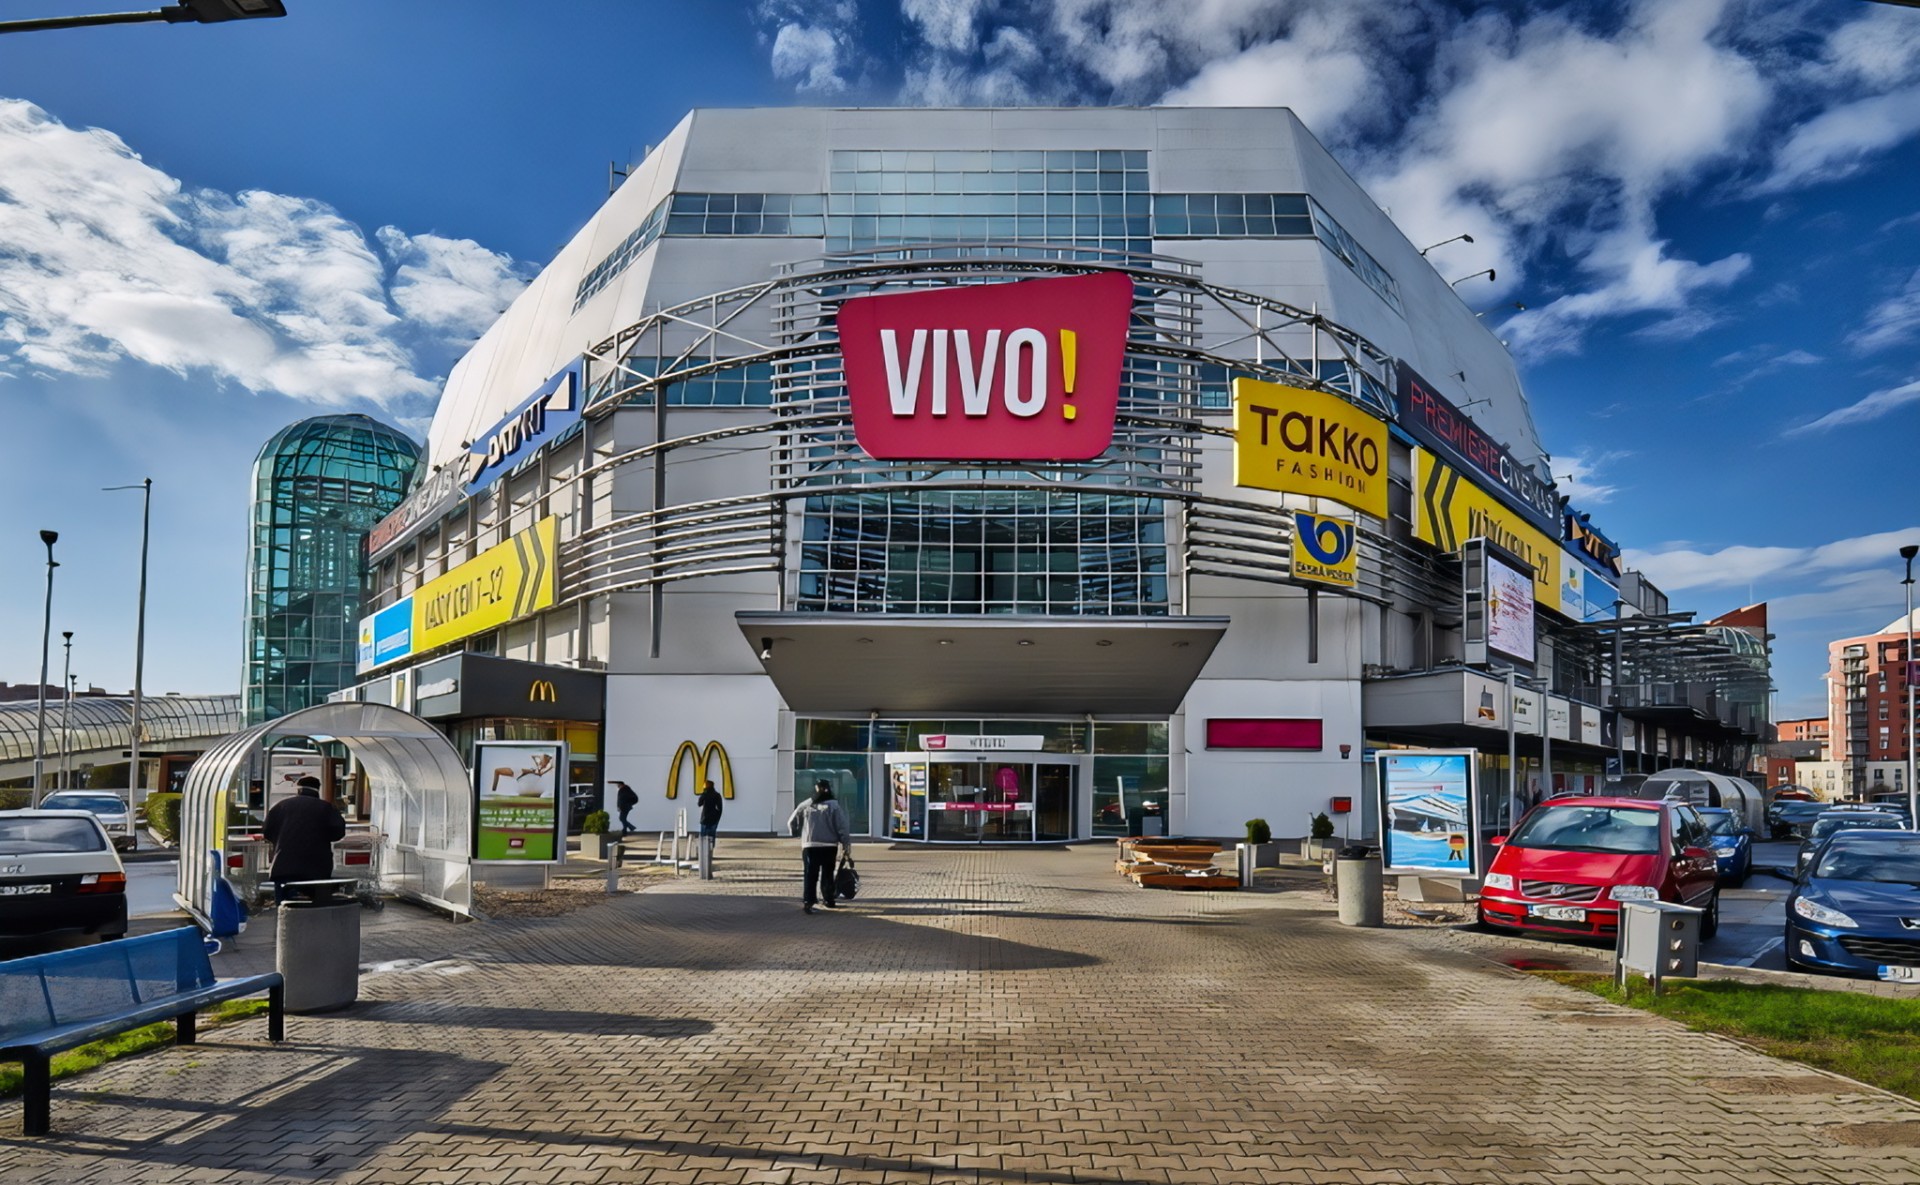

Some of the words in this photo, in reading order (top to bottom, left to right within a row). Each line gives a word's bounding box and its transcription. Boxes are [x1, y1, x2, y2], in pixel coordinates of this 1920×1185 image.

[880, 327, 1077, 421] VIVO!
[1410, 380, 1500, 477] PREMIERE
[1276, 459, 1366, 494] FASHION
